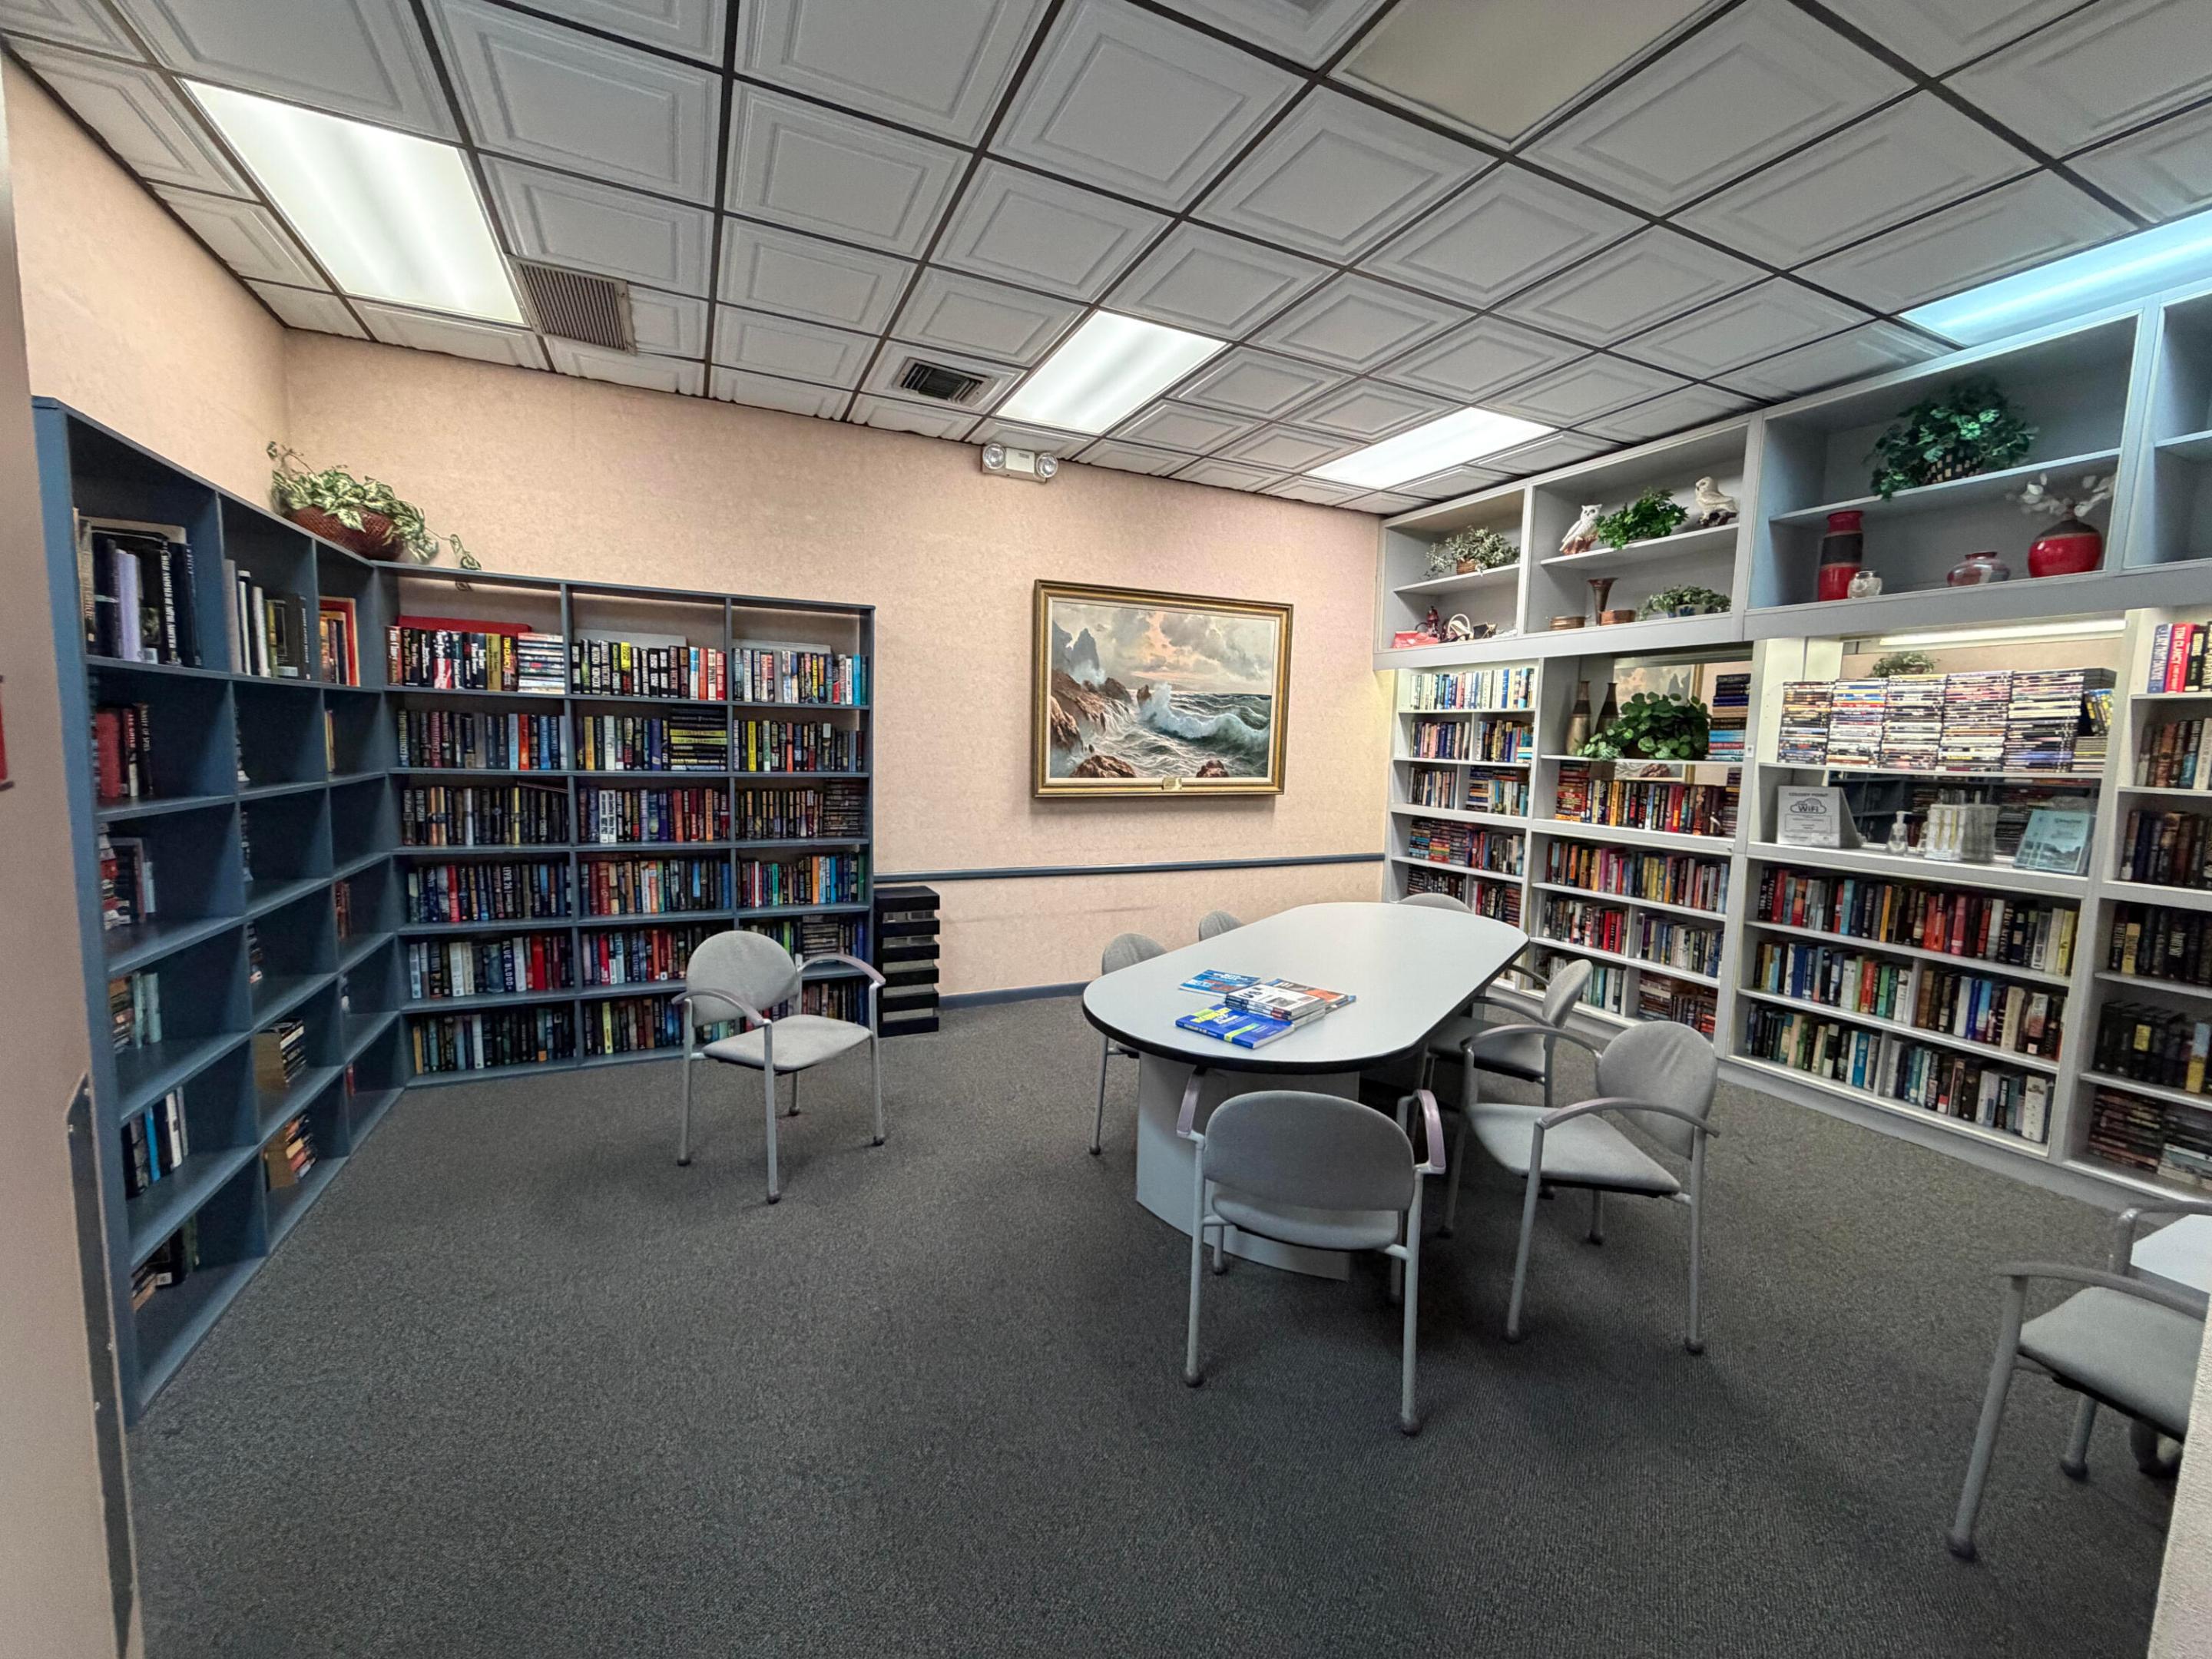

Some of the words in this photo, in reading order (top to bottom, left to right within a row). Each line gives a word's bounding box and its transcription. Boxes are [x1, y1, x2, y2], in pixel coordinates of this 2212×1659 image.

[2174, 627, 2186, 640] TOM
[2171, 641, 2184, 664] CLANCY
[505, 963, 514, 985] BLOOD
